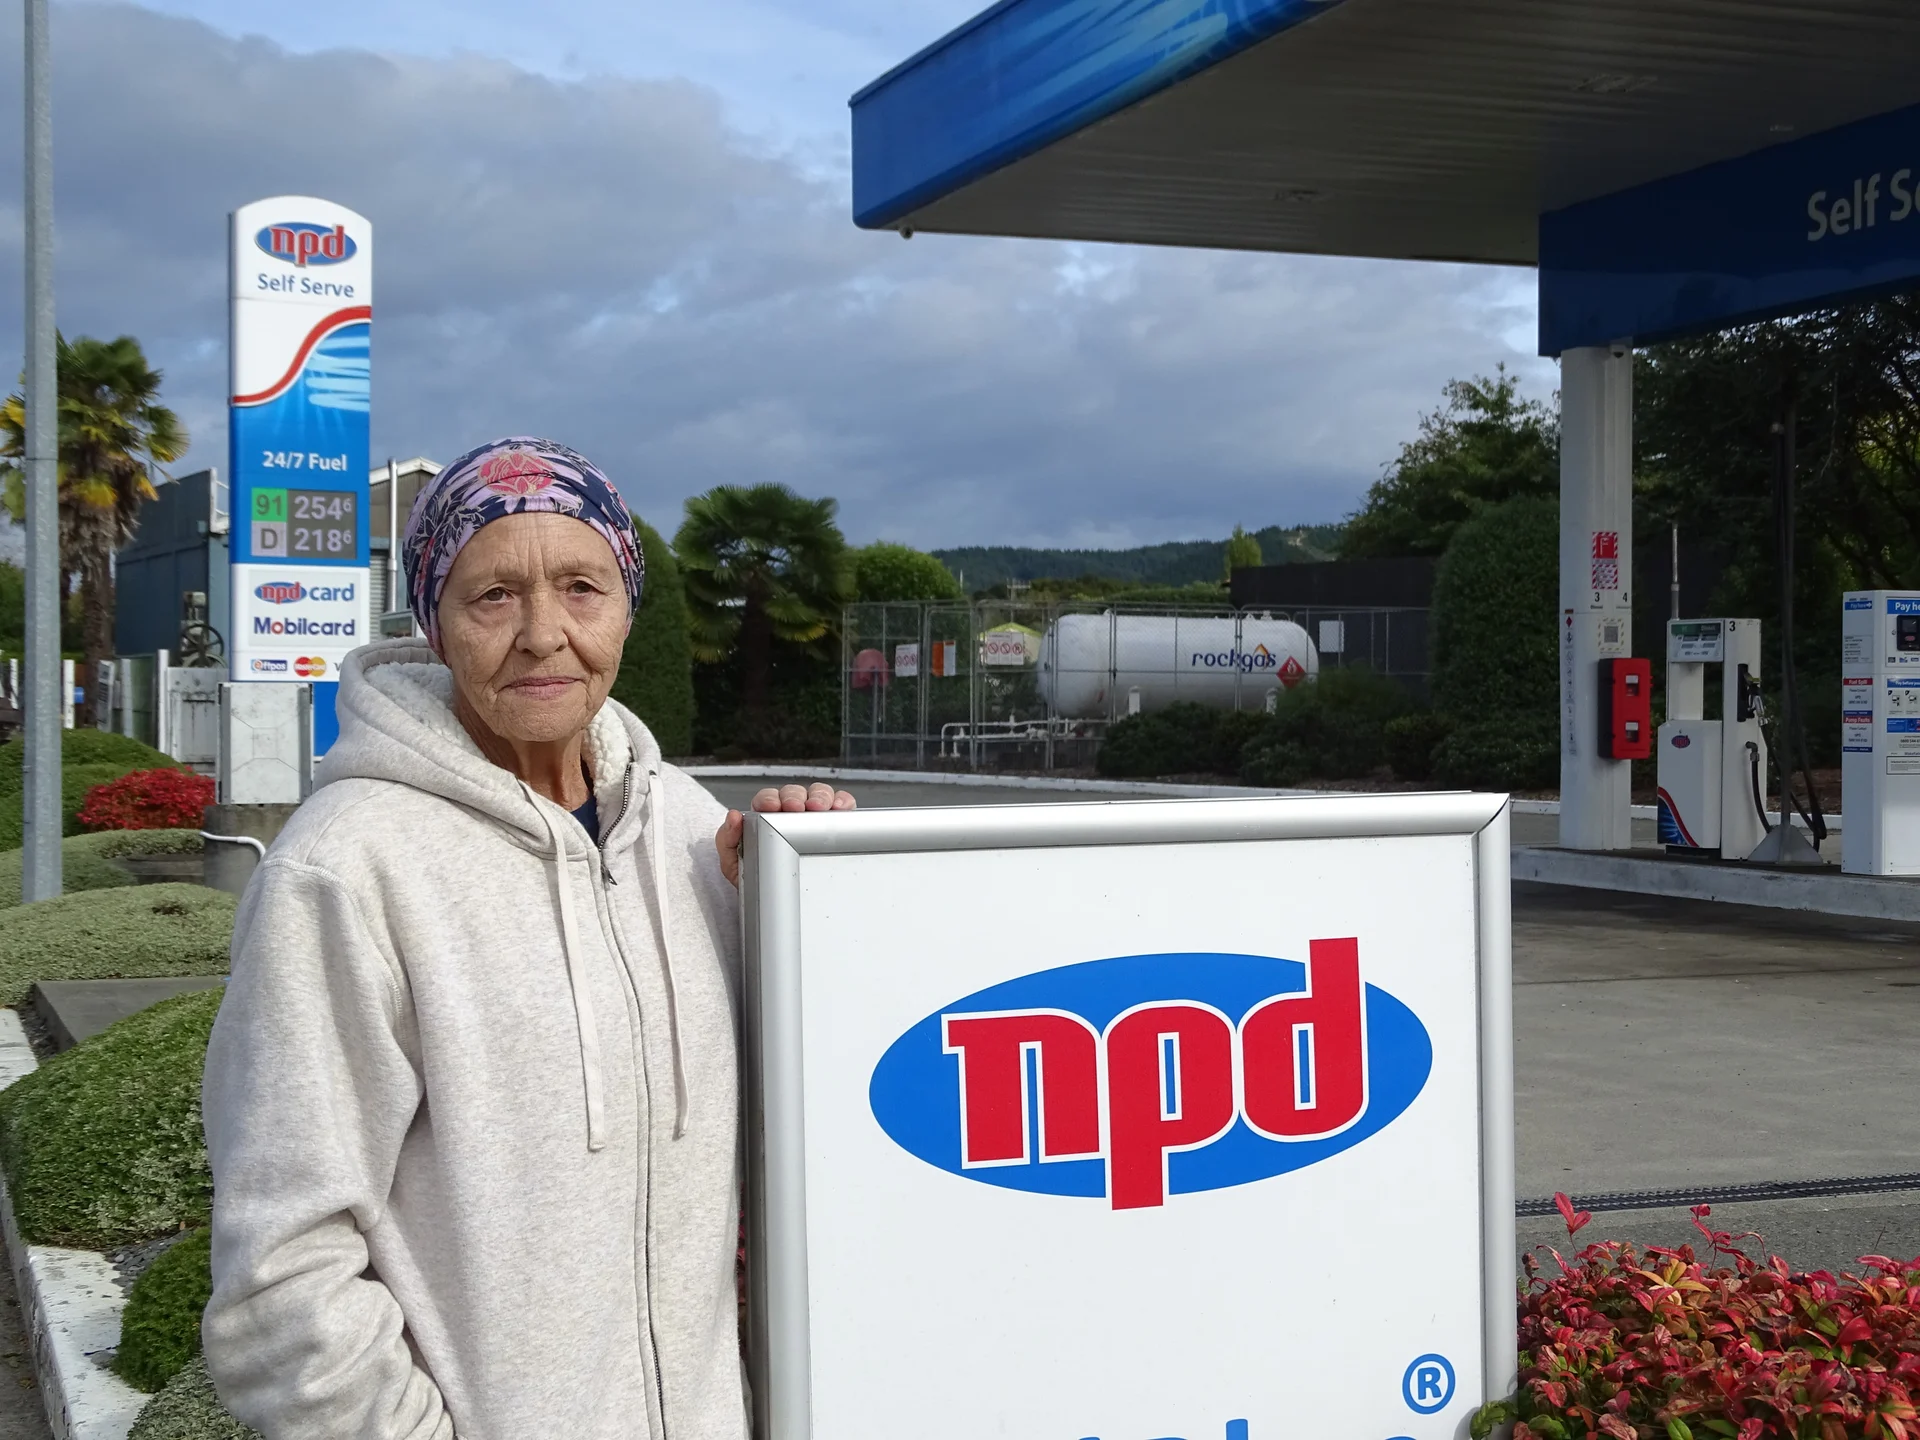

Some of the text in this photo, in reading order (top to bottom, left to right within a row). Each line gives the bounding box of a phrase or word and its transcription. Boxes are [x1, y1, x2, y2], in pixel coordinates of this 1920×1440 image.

[1807, 168, 1920, 241] Self S
[269, 224, 345, 267] npd
[257, 273, 355, 298] Self Serve
[262, 451, 348, 471] 24/7 Fuel
[256, 494, 282, 516] 91
[260, 528, 278, 550] D
[260, 582, 355, 605] npd card
[1595, 592, 1628, 602] 3 4
[1895, 602, 1911, 613] Pay
[254, 616, 355, 636] Mobilcard
[1729, 620, 1736, 632] 3
[1191, 648, 1277, 673] rockgas
[942, 937, 1369, 1211] npd
